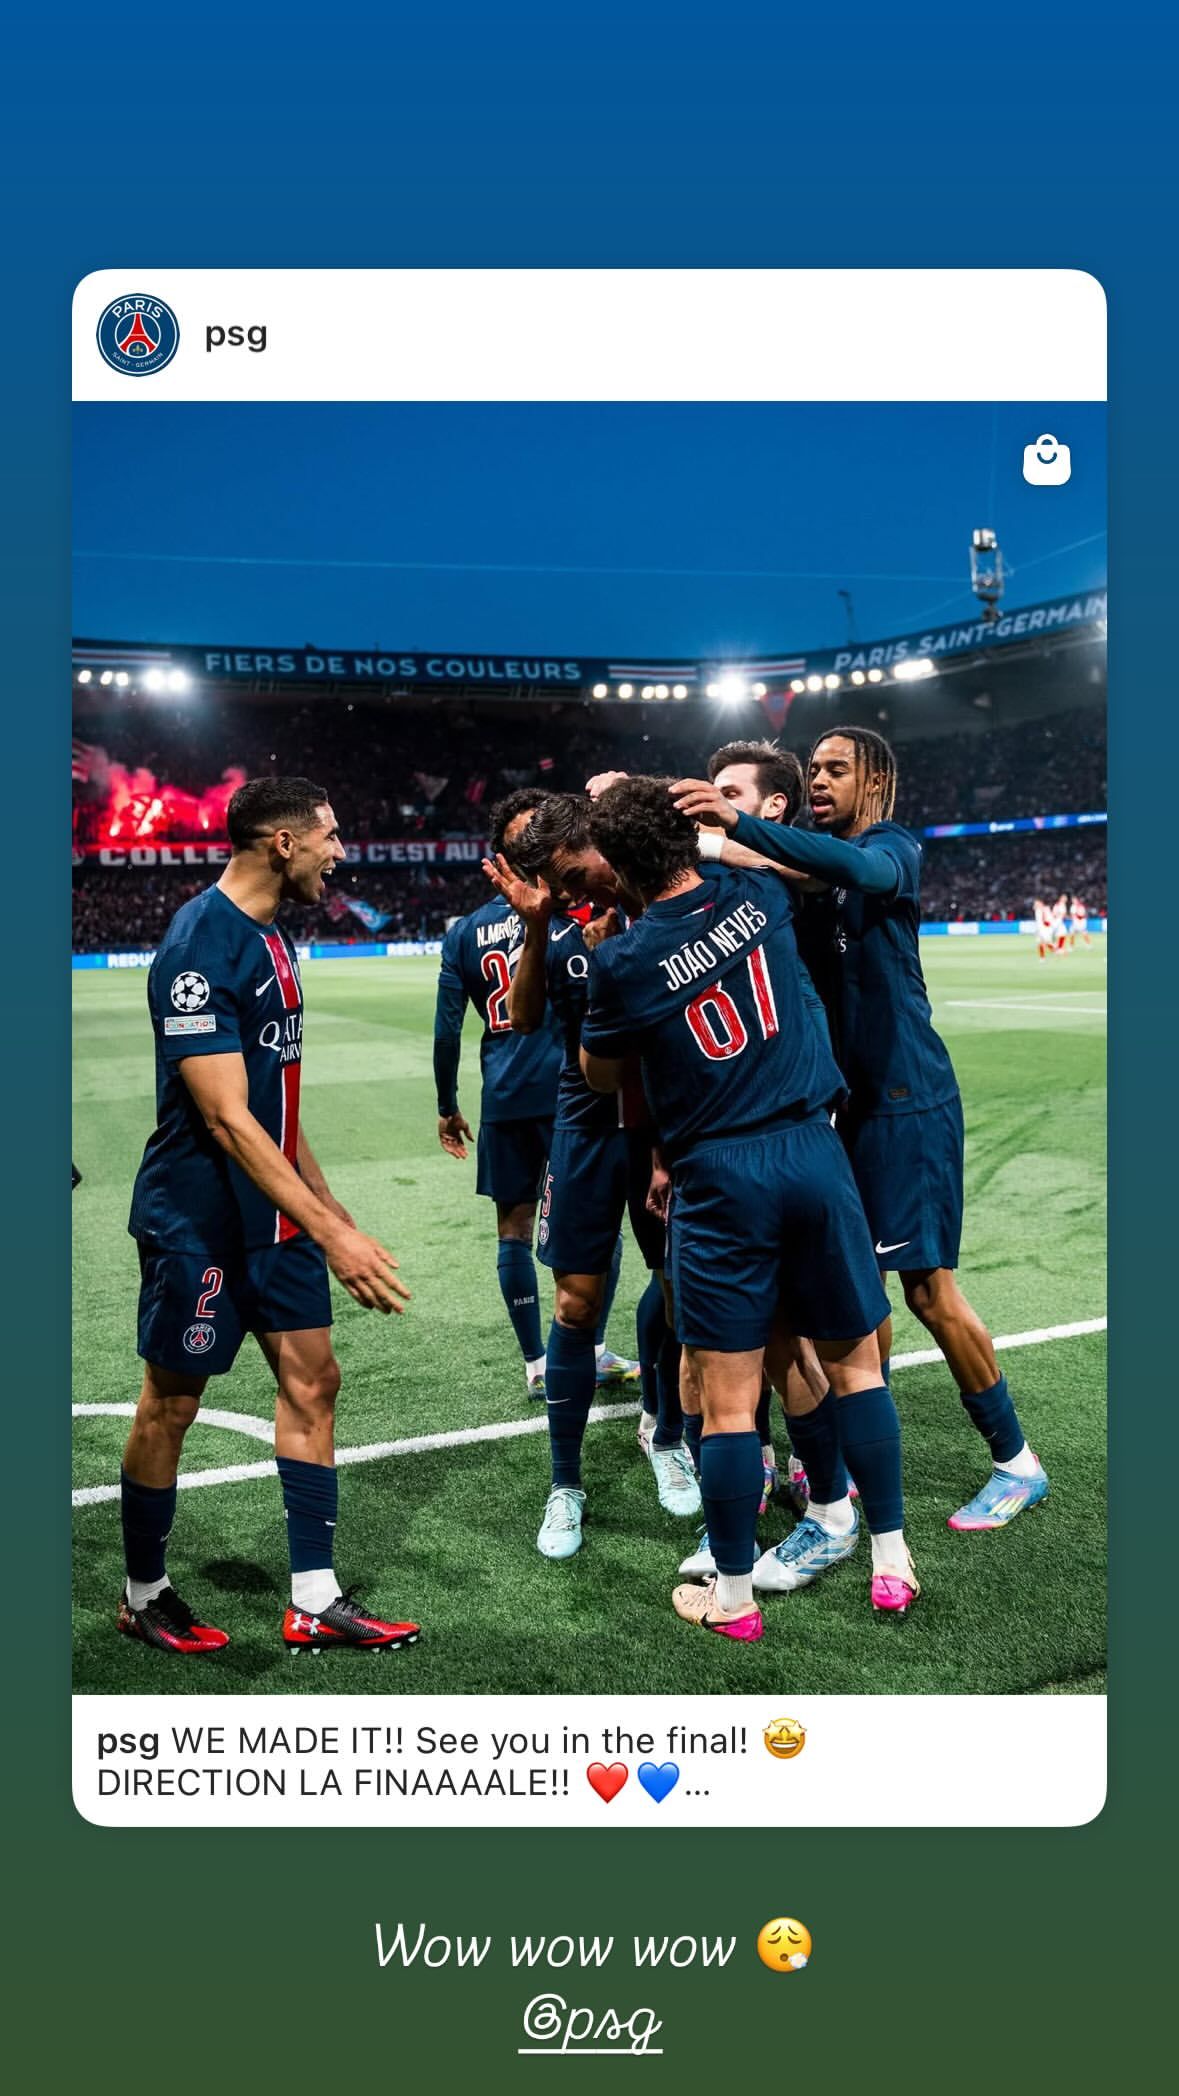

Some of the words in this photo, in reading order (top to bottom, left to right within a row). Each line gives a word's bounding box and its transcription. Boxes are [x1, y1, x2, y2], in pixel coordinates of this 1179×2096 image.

[204, 653, 296, 673] FIERS
[305, 656, 346, 675] DE
[353, 658, 417, 678] NOS
[425, 659, 582, 681] COULEURS
[832, 643, 909, 673] PARIS
[98, 846, 232, 866] COLLE
[367, 842, 438, 863] C'EST
[444, 842, 478, 862] AU
[107, 952, 156, 969] REDU
[657, 942, 718, 992] JOÃO
[707, 900, 768, 958] NEVES
[258, 1013, 303, 1052] QATA
[195, 1266, 224, 1319] 2
